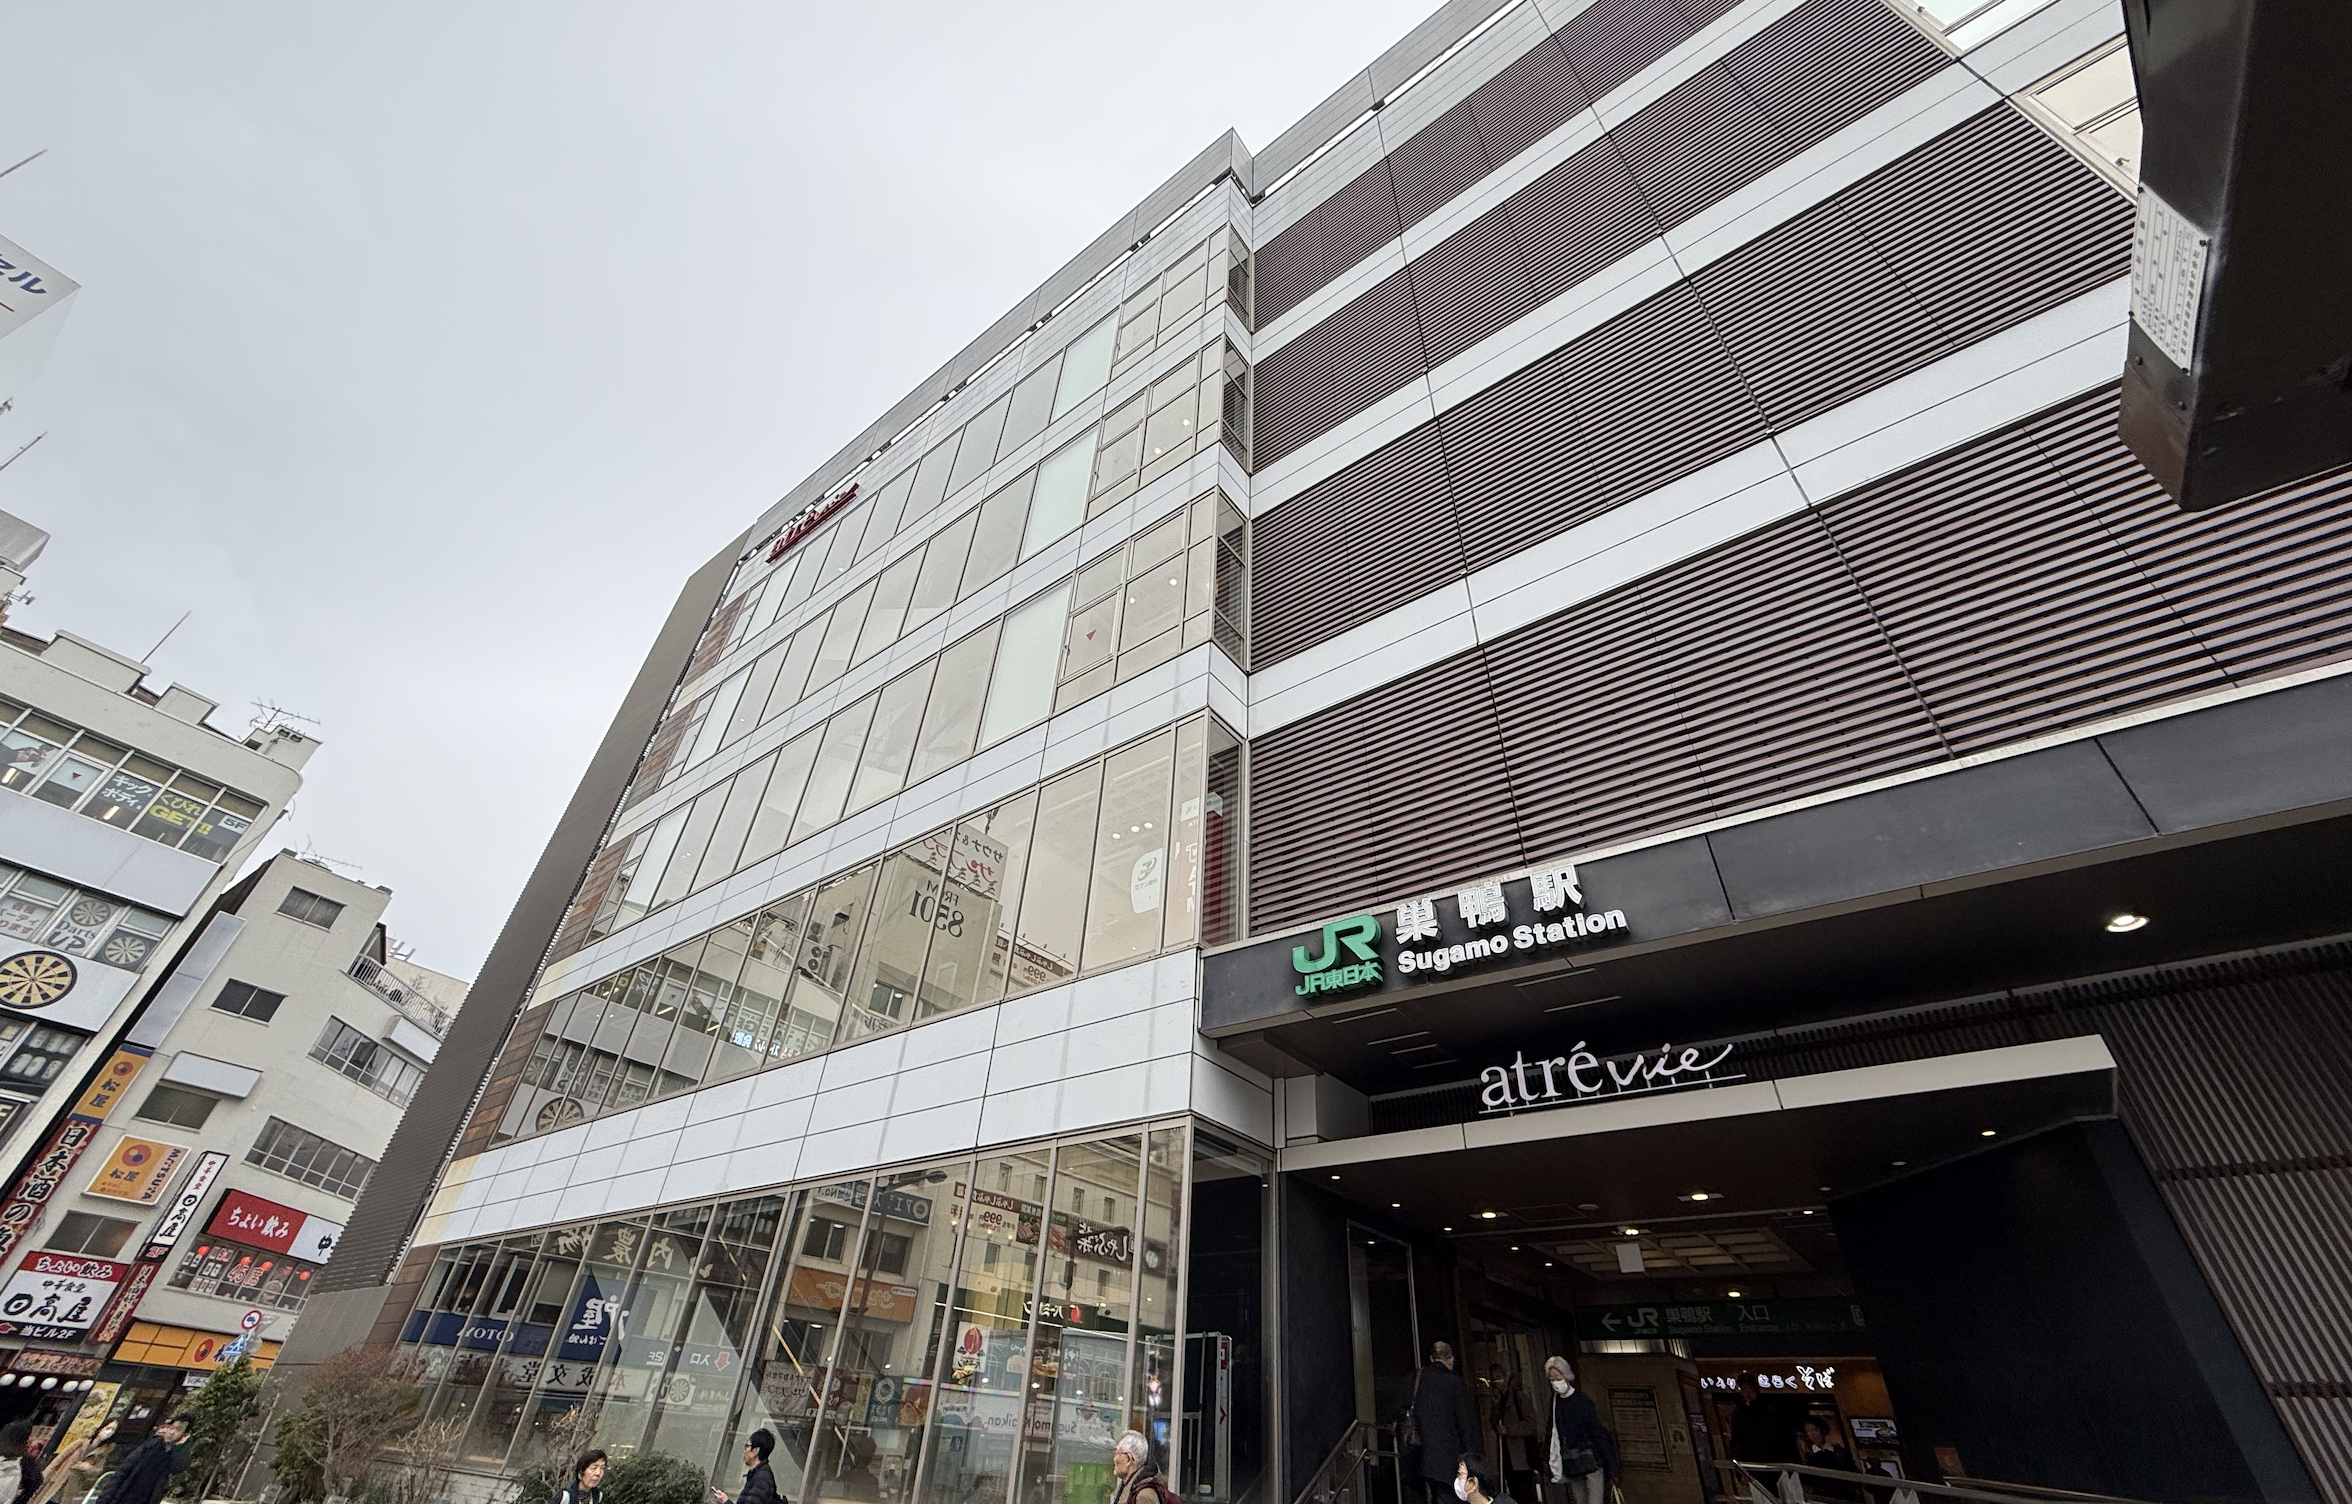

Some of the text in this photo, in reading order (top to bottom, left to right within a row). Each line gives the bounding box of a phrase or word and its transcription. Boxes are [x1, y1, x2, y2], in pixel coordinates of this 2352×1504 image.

[223, 817, 248, 830] 5F
[1396, 864, 1584, 946] 巣鴨駅
[57, 920, 99, 940] Darts
[1398, 906, 1630, 975] Sugamo Station
[1292, 914, 1381, 974] JR
[1295, 961, 1383, 996] JR東日本
[89, 1078, 121, 1108] 松屋
[109, 1168, 140, 1182] 松屋
[158, 1194, 198, 1238] 日高屋
[228, 1206, 290, 1238] ちょい飲み
[35, 1256, 113, 1278] ちょい飲み
[42, 1278, 87, 1294] 中華食堂
[3, 1293, 92, 1323] 日高屋
[1627, 1307, 1660, 1328] JR
[1666, 1305, 1772, 1323] 巣鴨駅 入口
[19, 1325, 77, 1340] 当ビル2F
[1668, 1325, 1703, 1335] Sugamo
[1704, 1324, 1734, 1333] Station
[1740, 1323, 1779, 1333] Entrance
